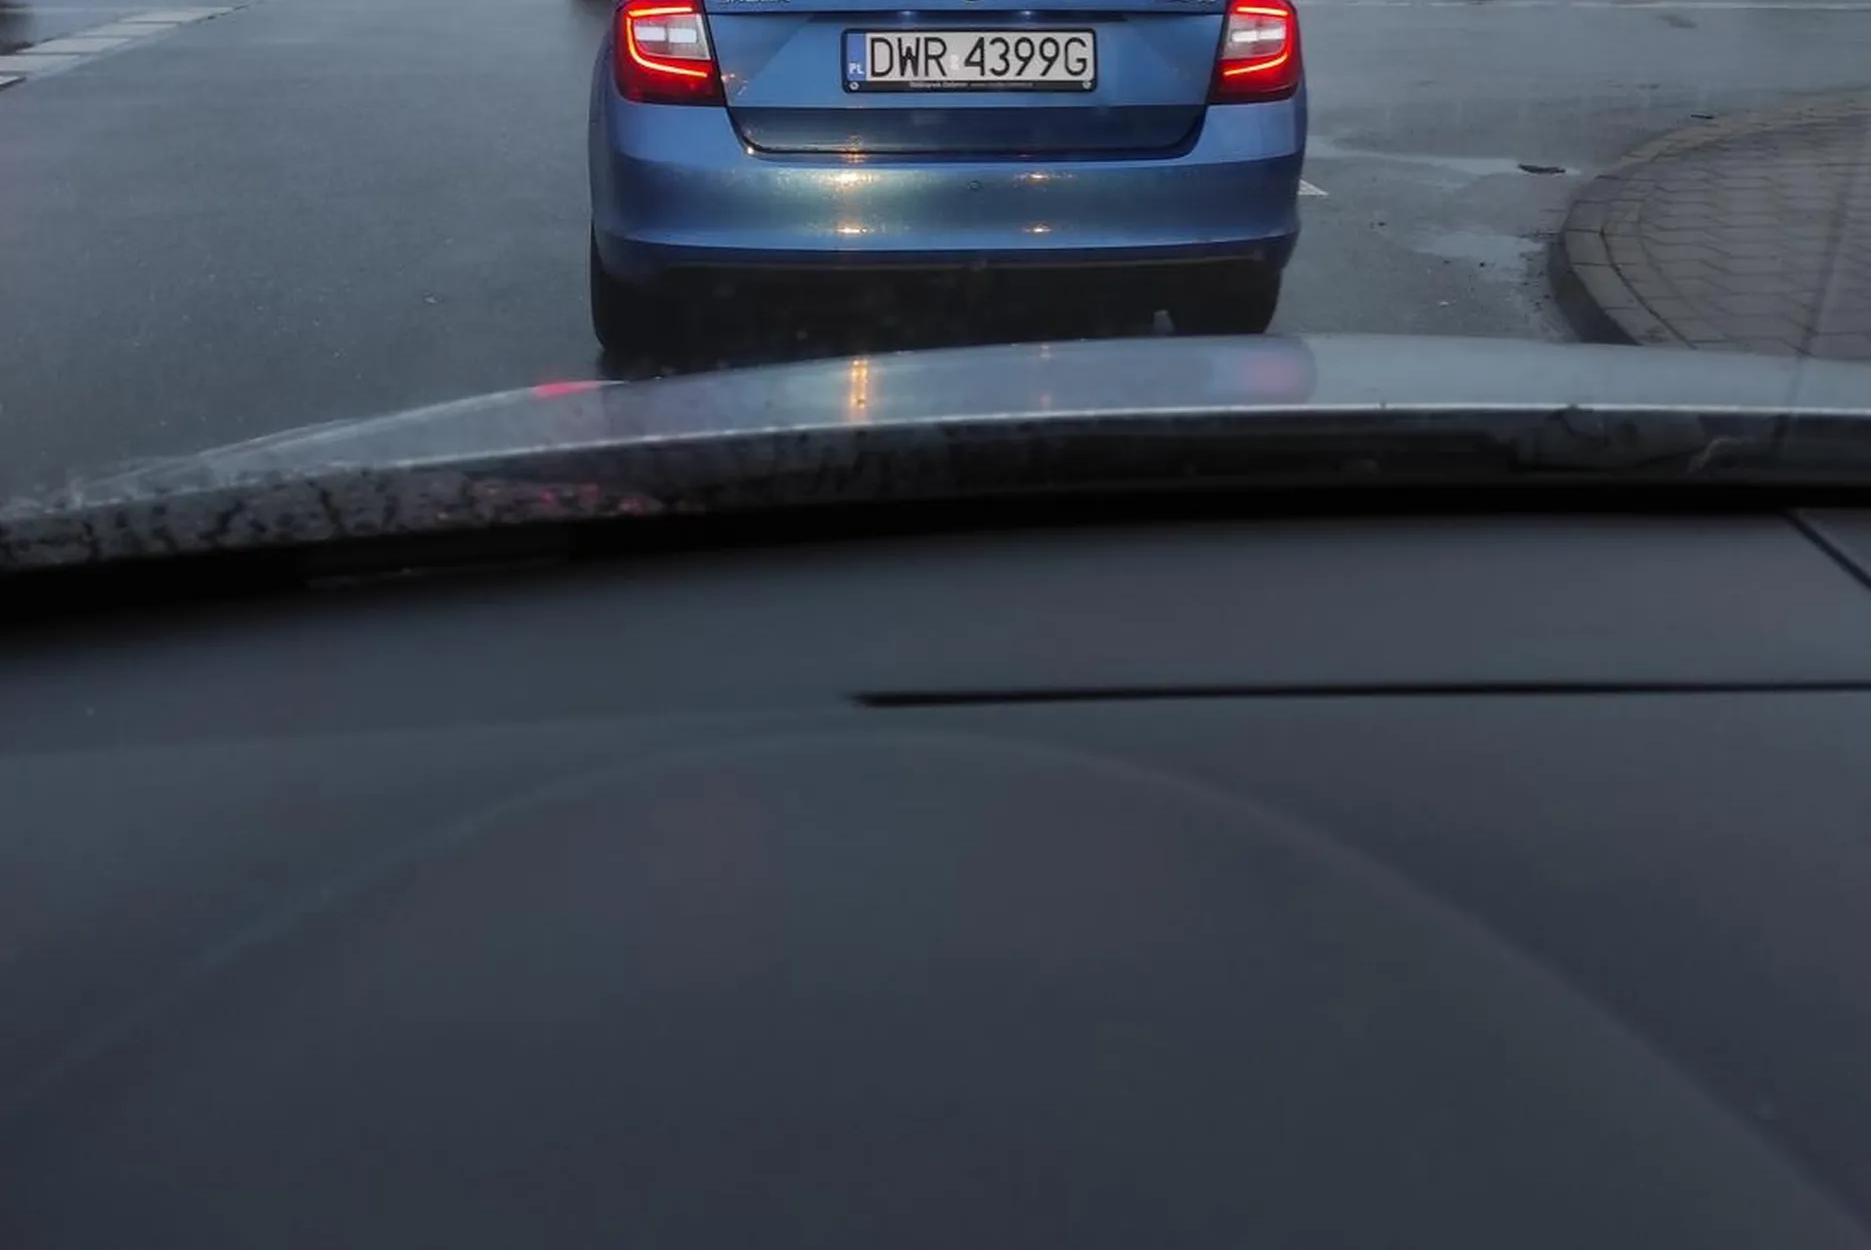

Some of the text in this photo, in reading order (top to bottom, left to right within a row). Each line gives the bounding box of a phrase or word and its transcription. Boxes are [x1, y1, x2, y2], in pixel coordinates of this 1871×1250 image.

[849, 63, 865, 75] PL
[870, 36, 1088, 77] DWR 4399G
